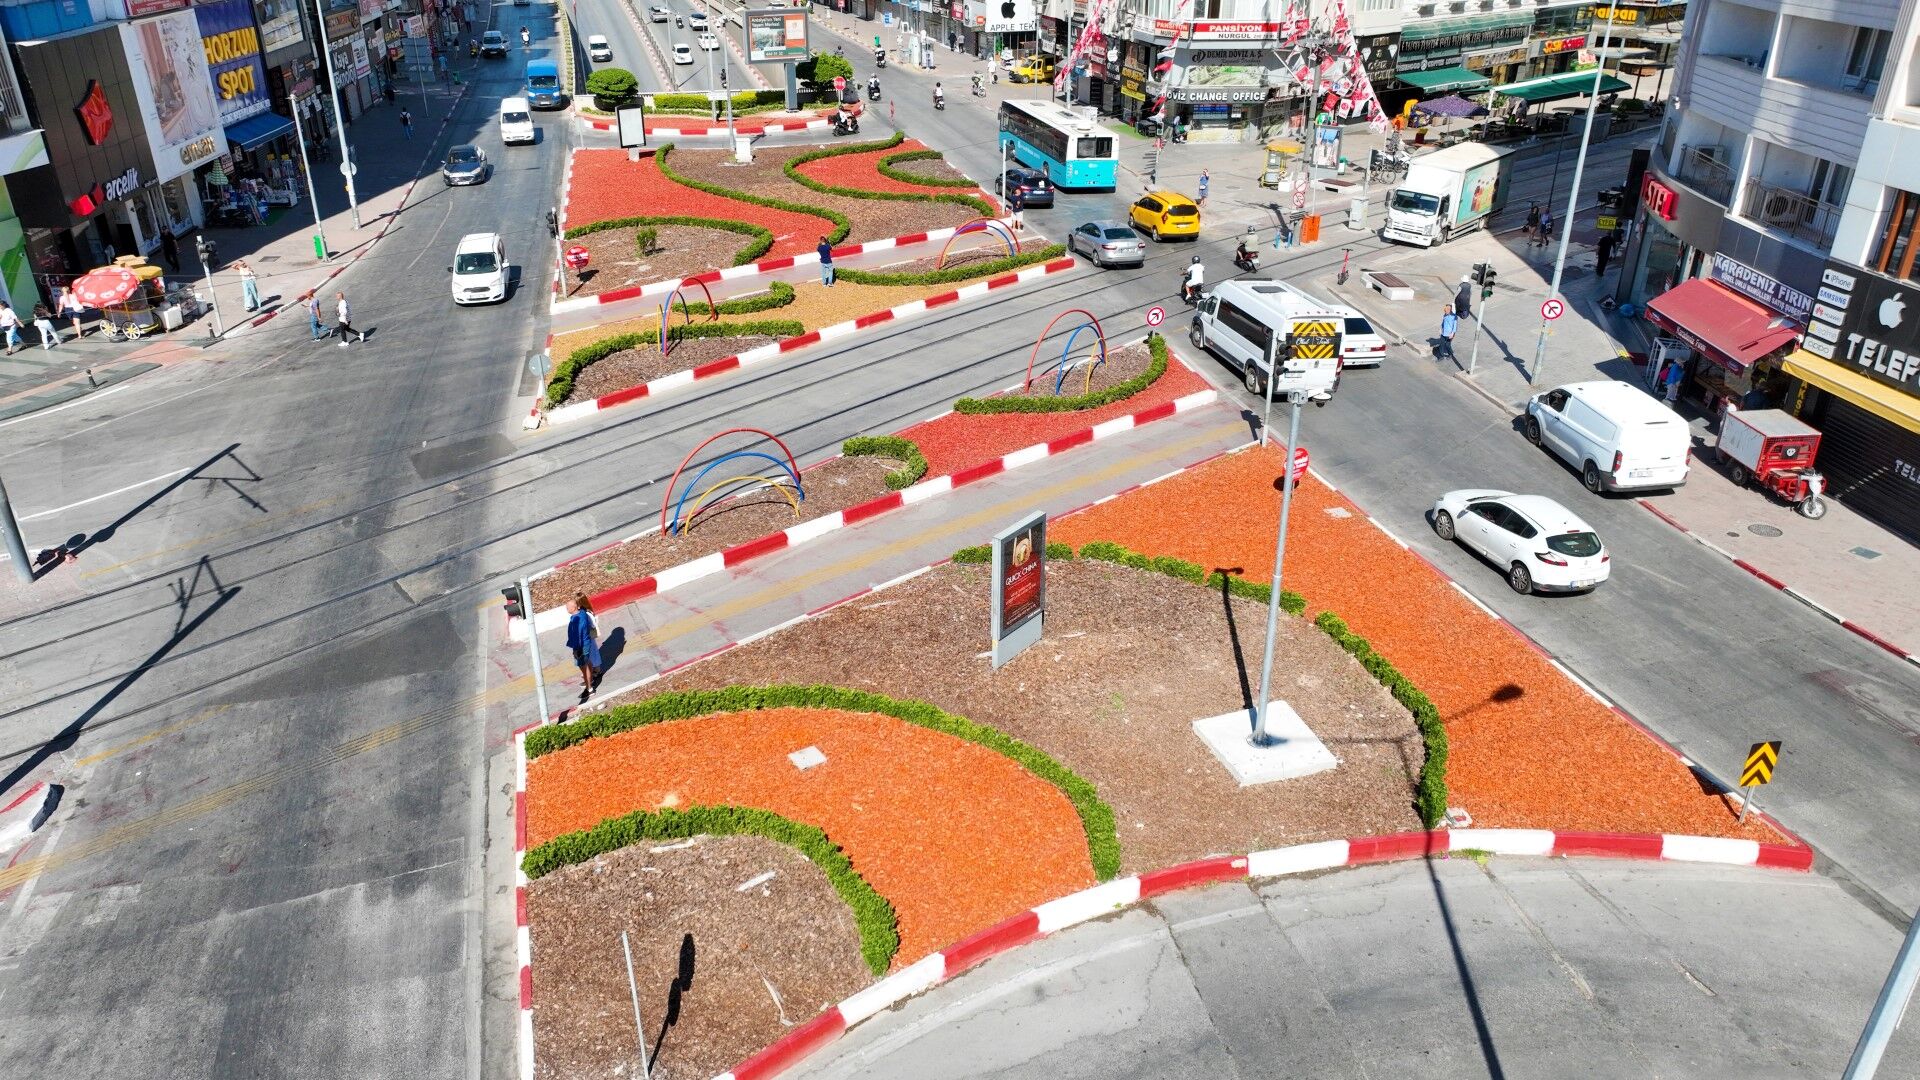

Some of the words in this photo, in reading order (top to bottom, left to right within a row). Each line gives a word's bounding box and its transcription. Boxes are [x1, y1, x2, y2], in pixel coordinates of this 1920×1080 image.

[1020, 21, 1037, 30] TEK
[1209, 24, 1262, 32] PANSİYON
[201, 27, 259, 65] HORZUM
[218, 65, 255, 99] SPOT
[1190, 92, 1228, 101] CHANGE
[1233, 92, 1266, 101] OFFICE
[105, 167, 139, 201] arçelik
[1830, 275, 1852, 288] iPhone
[1778, 286, 1812, 312] FIRIN
[1820, 290, 1847, 305] SAMSUNG
[1847, 332, 1920, 387] TELEF
[1005, 573, 1022, 586] QUICK
[1021, 562, 1037, 575] CHINA
